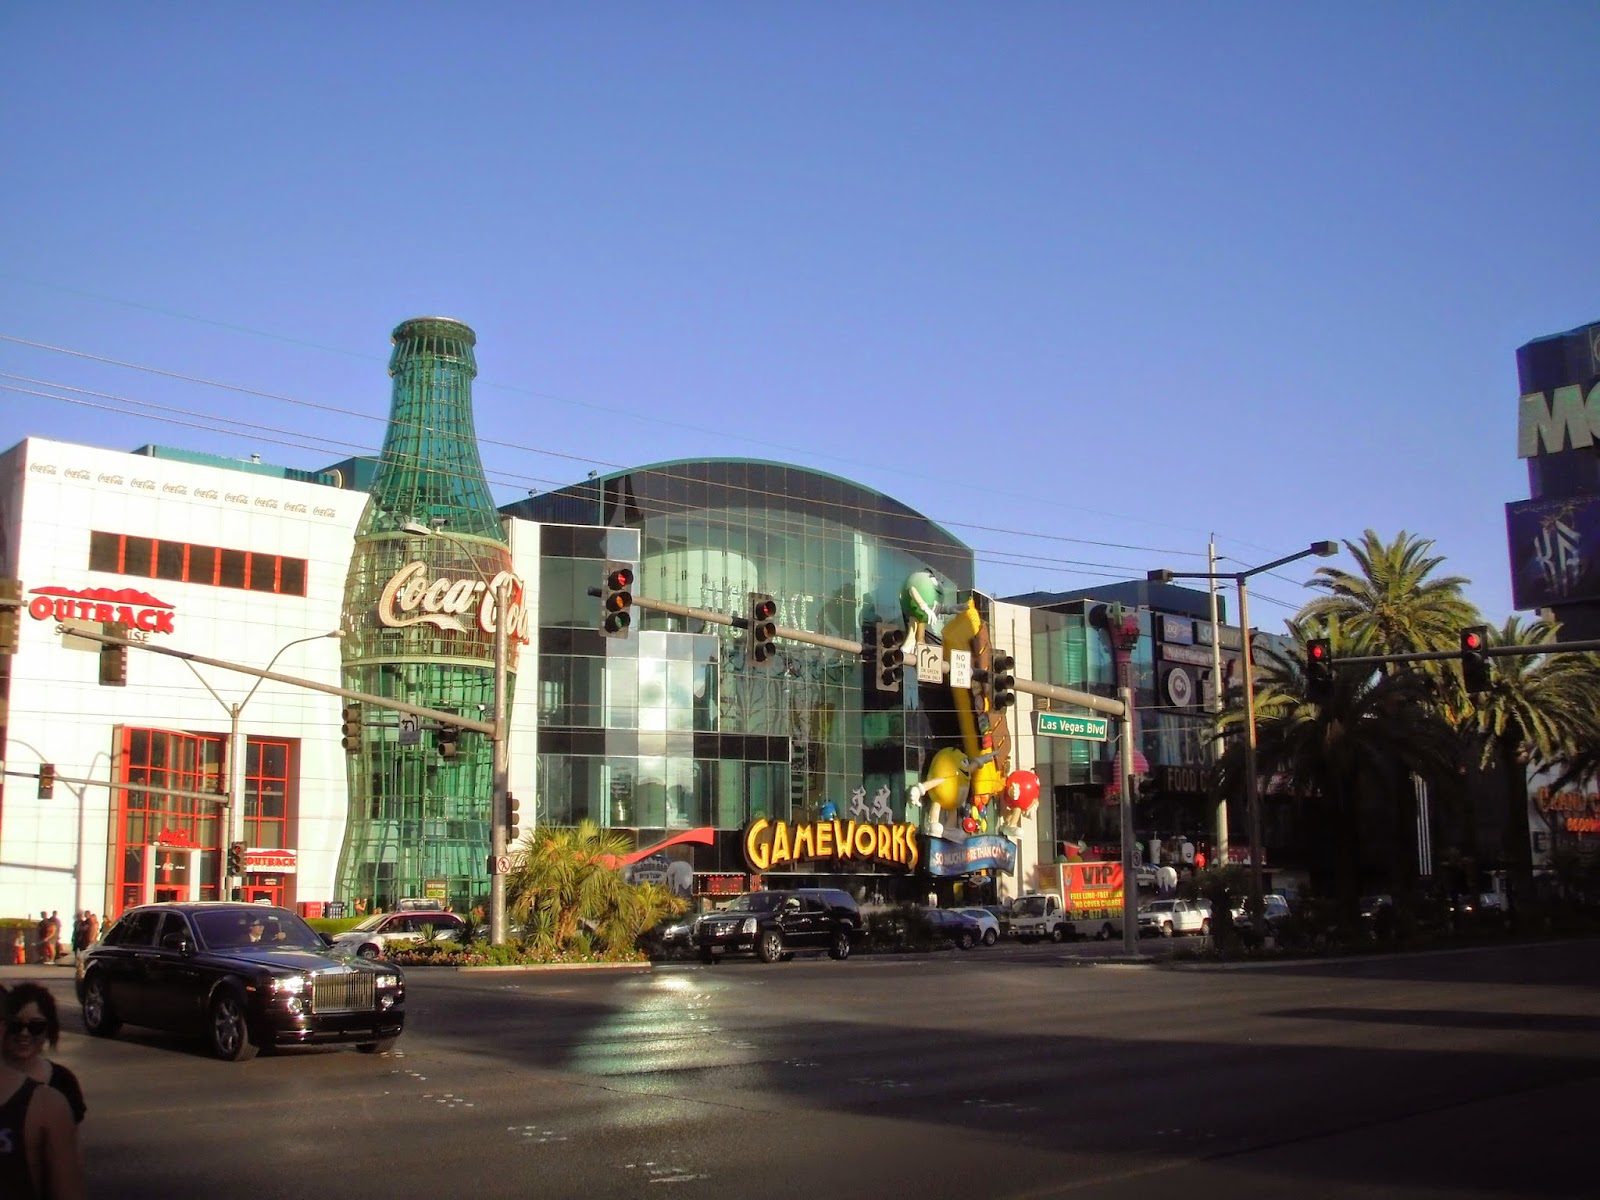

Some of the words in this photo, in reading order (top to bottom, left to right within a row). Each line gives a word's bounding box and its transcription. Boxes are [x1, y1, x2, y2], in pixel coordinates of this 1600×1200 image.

[29, 596, 176, 635] OUTBACK
[1041, 718, 1057, 730] Las
[1059, 720, 1084, 735] Vegas
[1087, 723, 1105, 735] Blvd
[1168, 768, 1196, 792] FOOD
[747, 818, 919, 870] GAMEWORKS
[246, 857, 296, 867] OUTBACK
[1081, 866, 1114, 885] VIP
[1083, 900, 1101, 908] COVER
